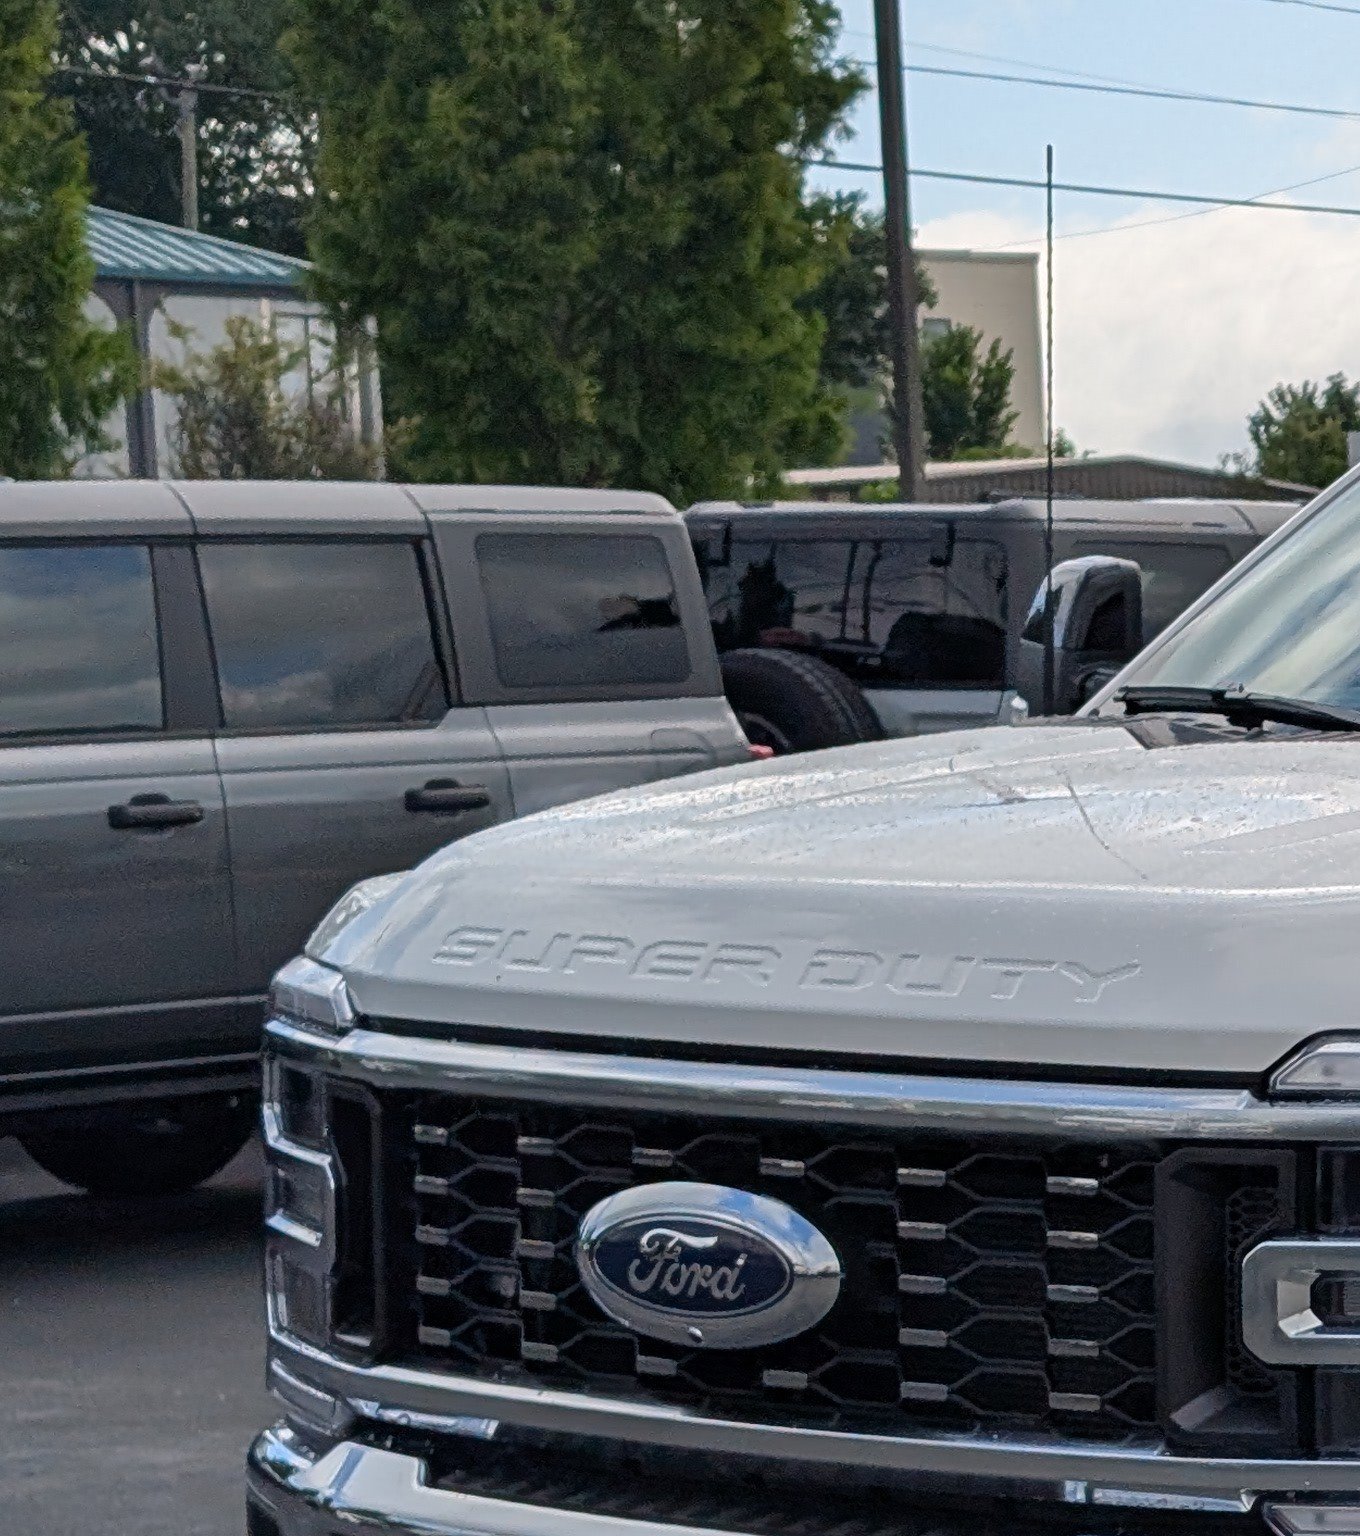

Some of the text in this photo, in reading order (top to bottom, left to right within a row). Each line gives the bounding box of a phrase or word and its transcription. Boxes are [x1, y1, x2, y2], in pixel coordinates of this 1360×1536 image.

[432, 925, 1142, 1004] SUPER DUTY
[627, 1228, 747, 1300] Ford
